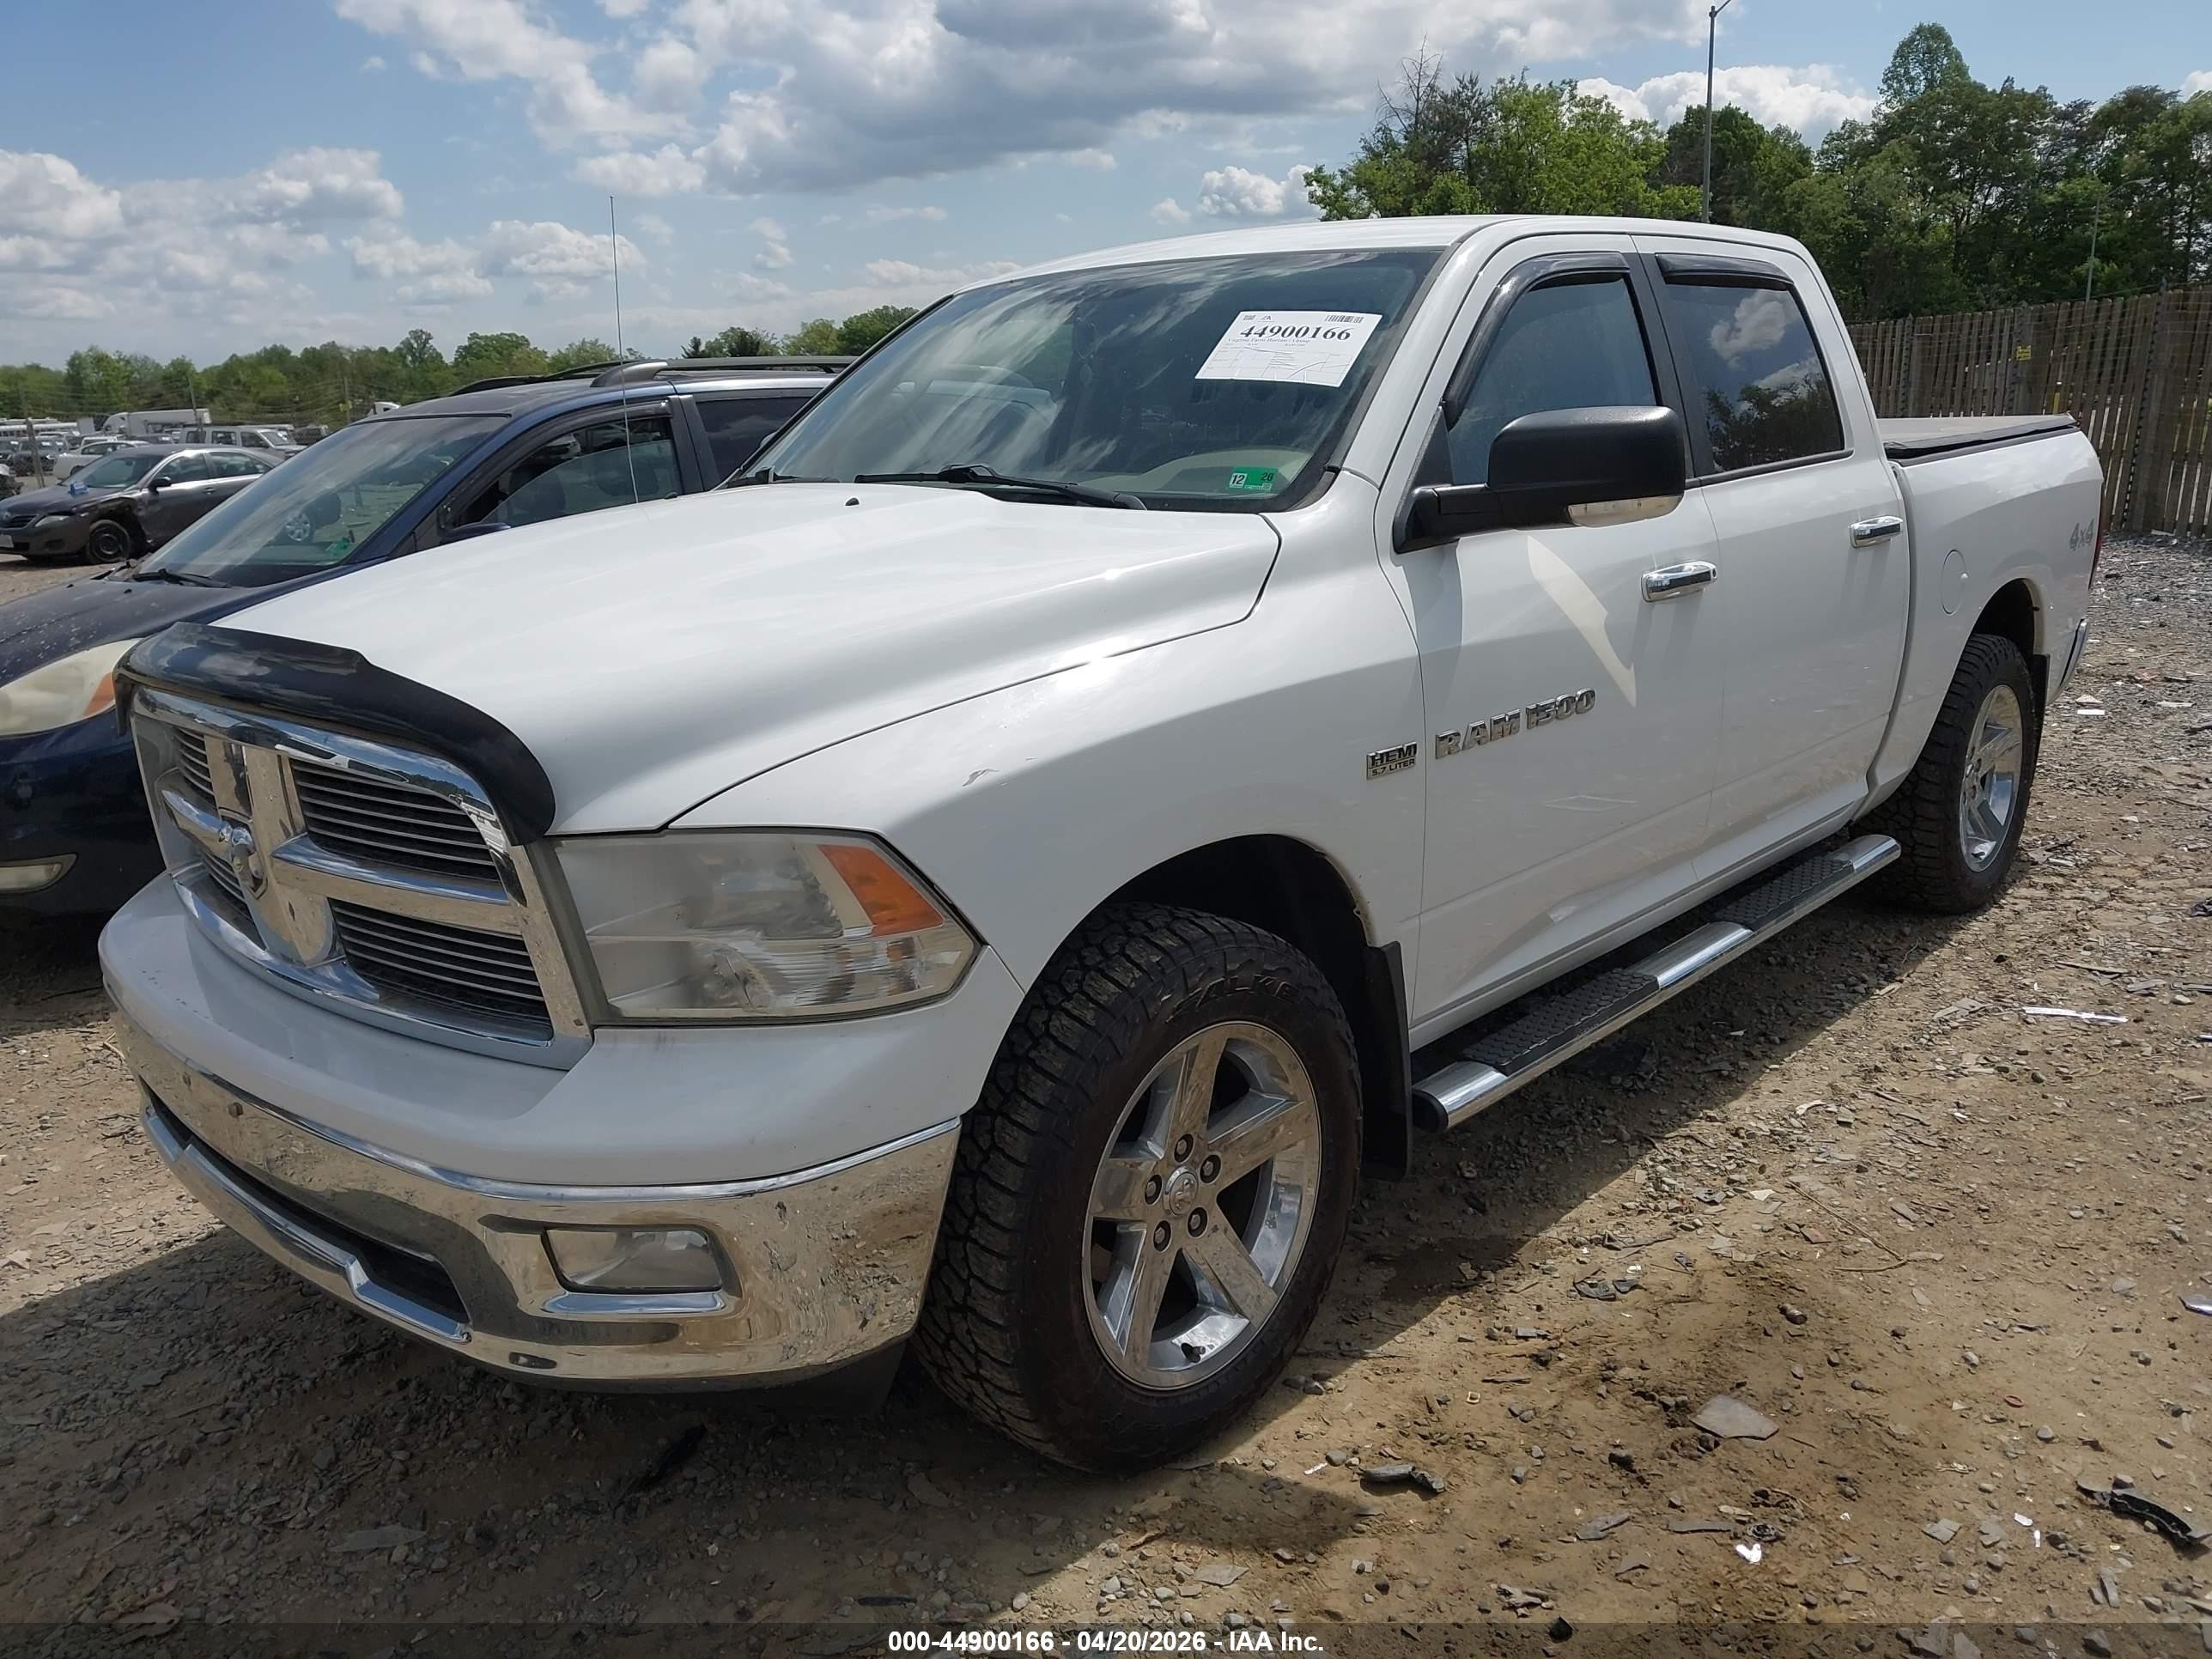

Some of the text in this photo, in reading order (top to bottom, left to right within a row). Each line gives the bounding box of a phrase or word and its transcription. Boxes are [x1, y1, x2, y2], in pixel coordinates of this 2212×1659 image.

[1240, 325, 1353, 340] 44900166
[1232, 474, 1245, 485] 12
[2069, 518, 2094, 551] 4x4
[1435, 688, 1595, 760] RAM 1500
[1367, 742, 1417, 768] HEMI
[1371, 757, 1415, 776] 5.7 LITER
